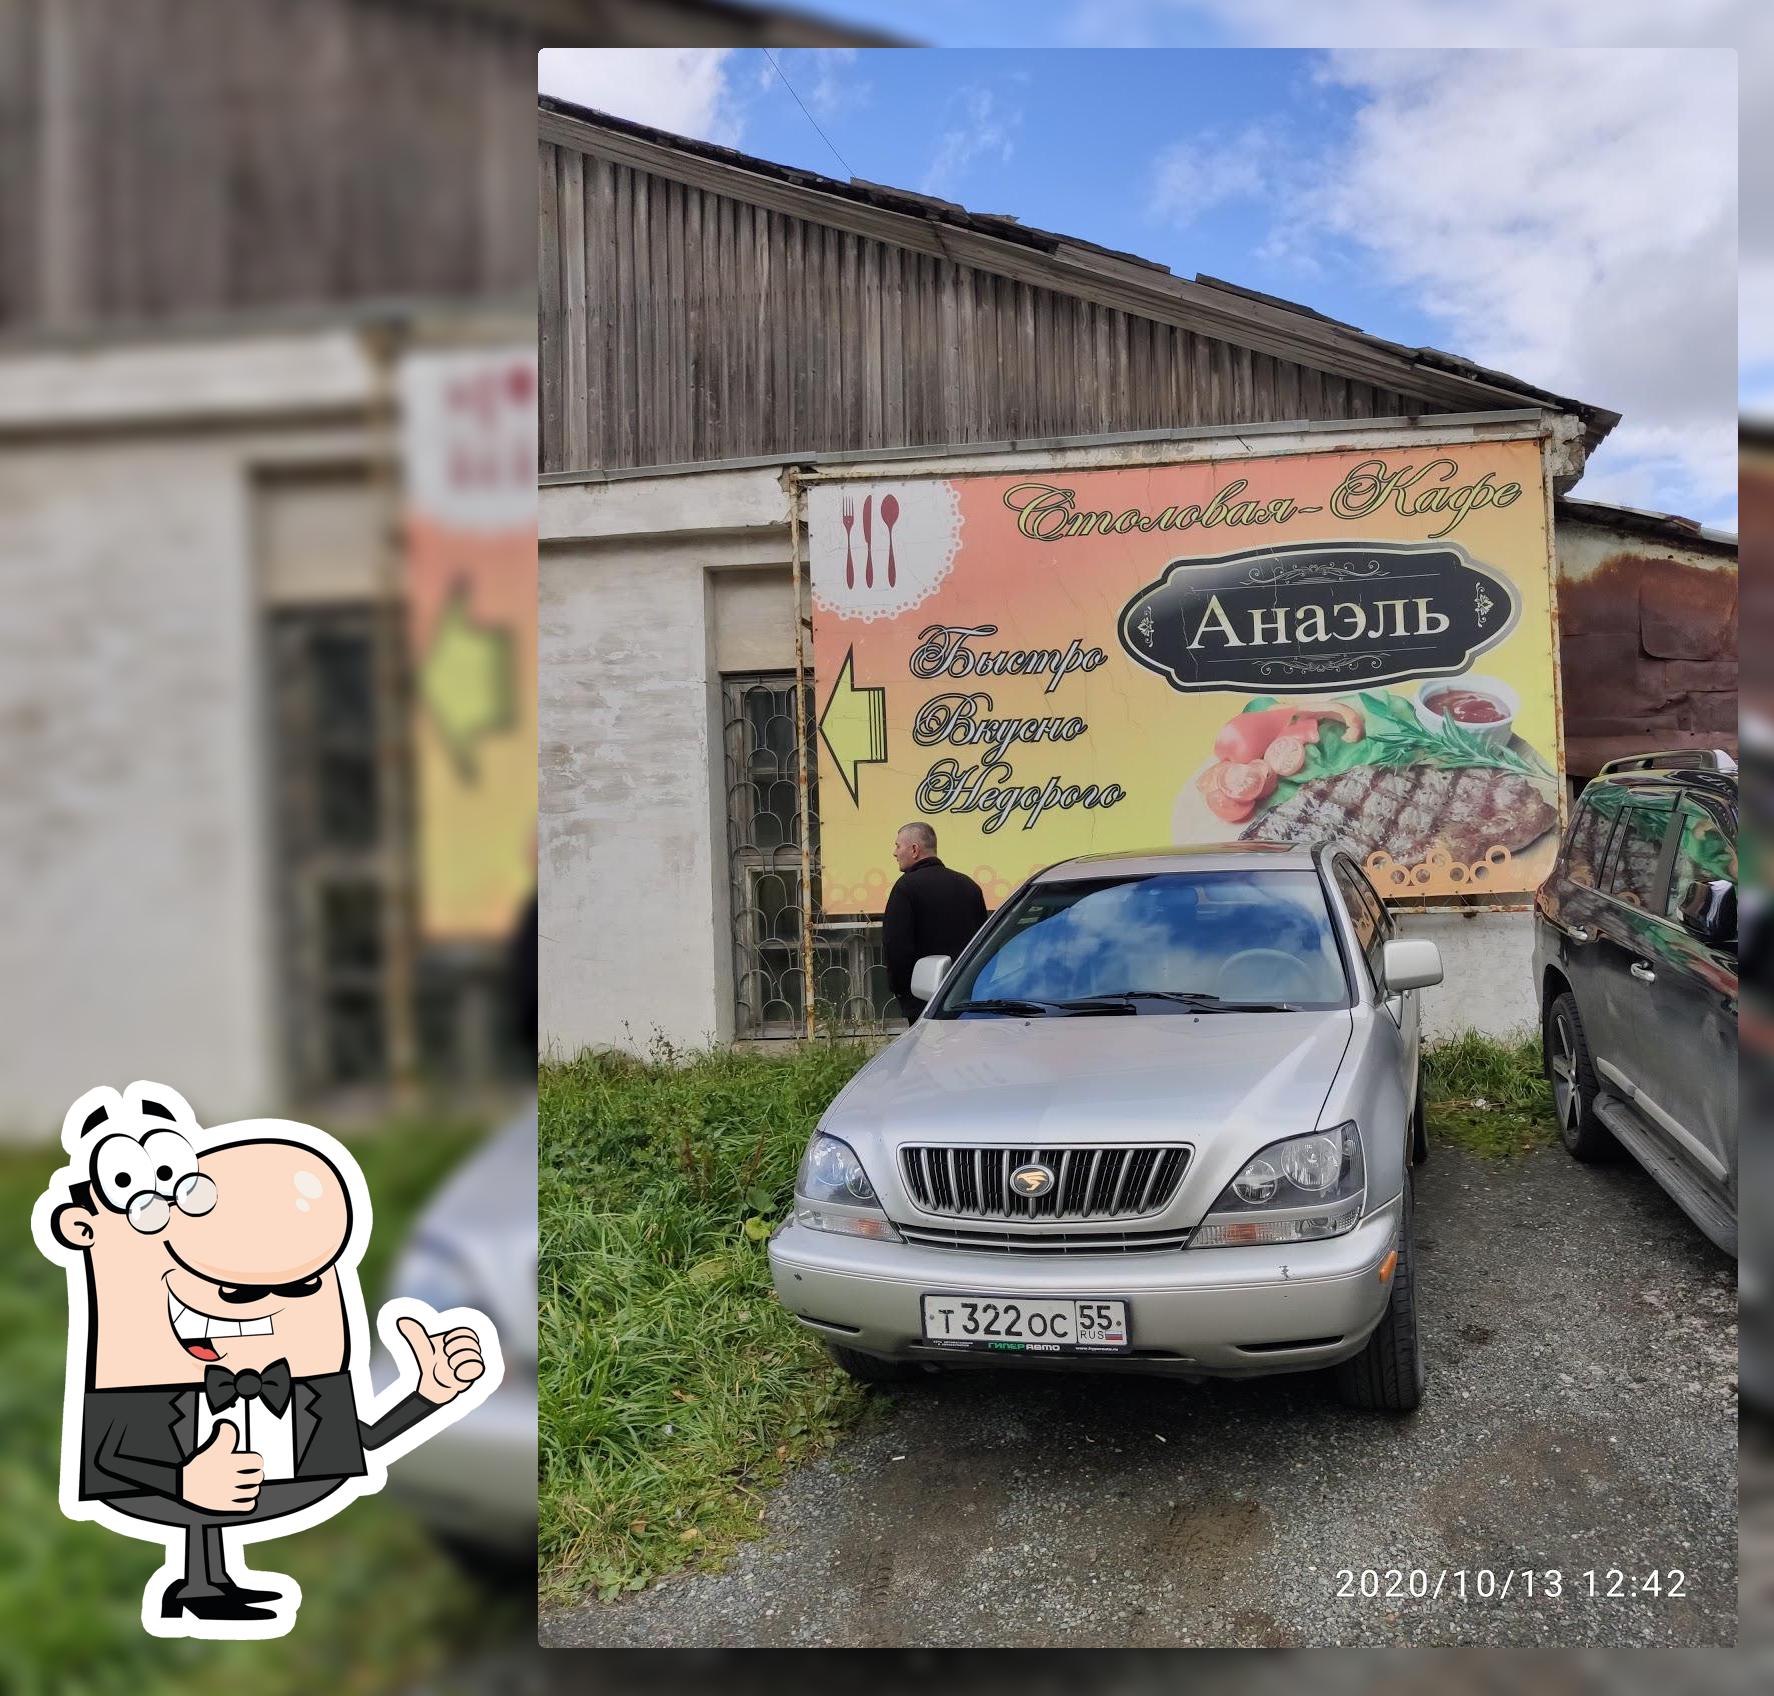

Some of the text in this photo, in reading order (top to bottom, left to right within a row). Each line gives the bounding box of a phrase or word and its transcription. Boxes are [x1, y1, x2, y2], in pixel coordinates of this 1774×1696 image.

[1186, 594, 1450, 649] Анаэль
[909, 624, 1108, 695] Быстро
[912, 692, 1088, 766] Вкусно
[915, 758, 1127, 834] Недорого
[1079, 1305, 1113, 1330] 55
[1080, 1330, 1104, 1340] RUS
